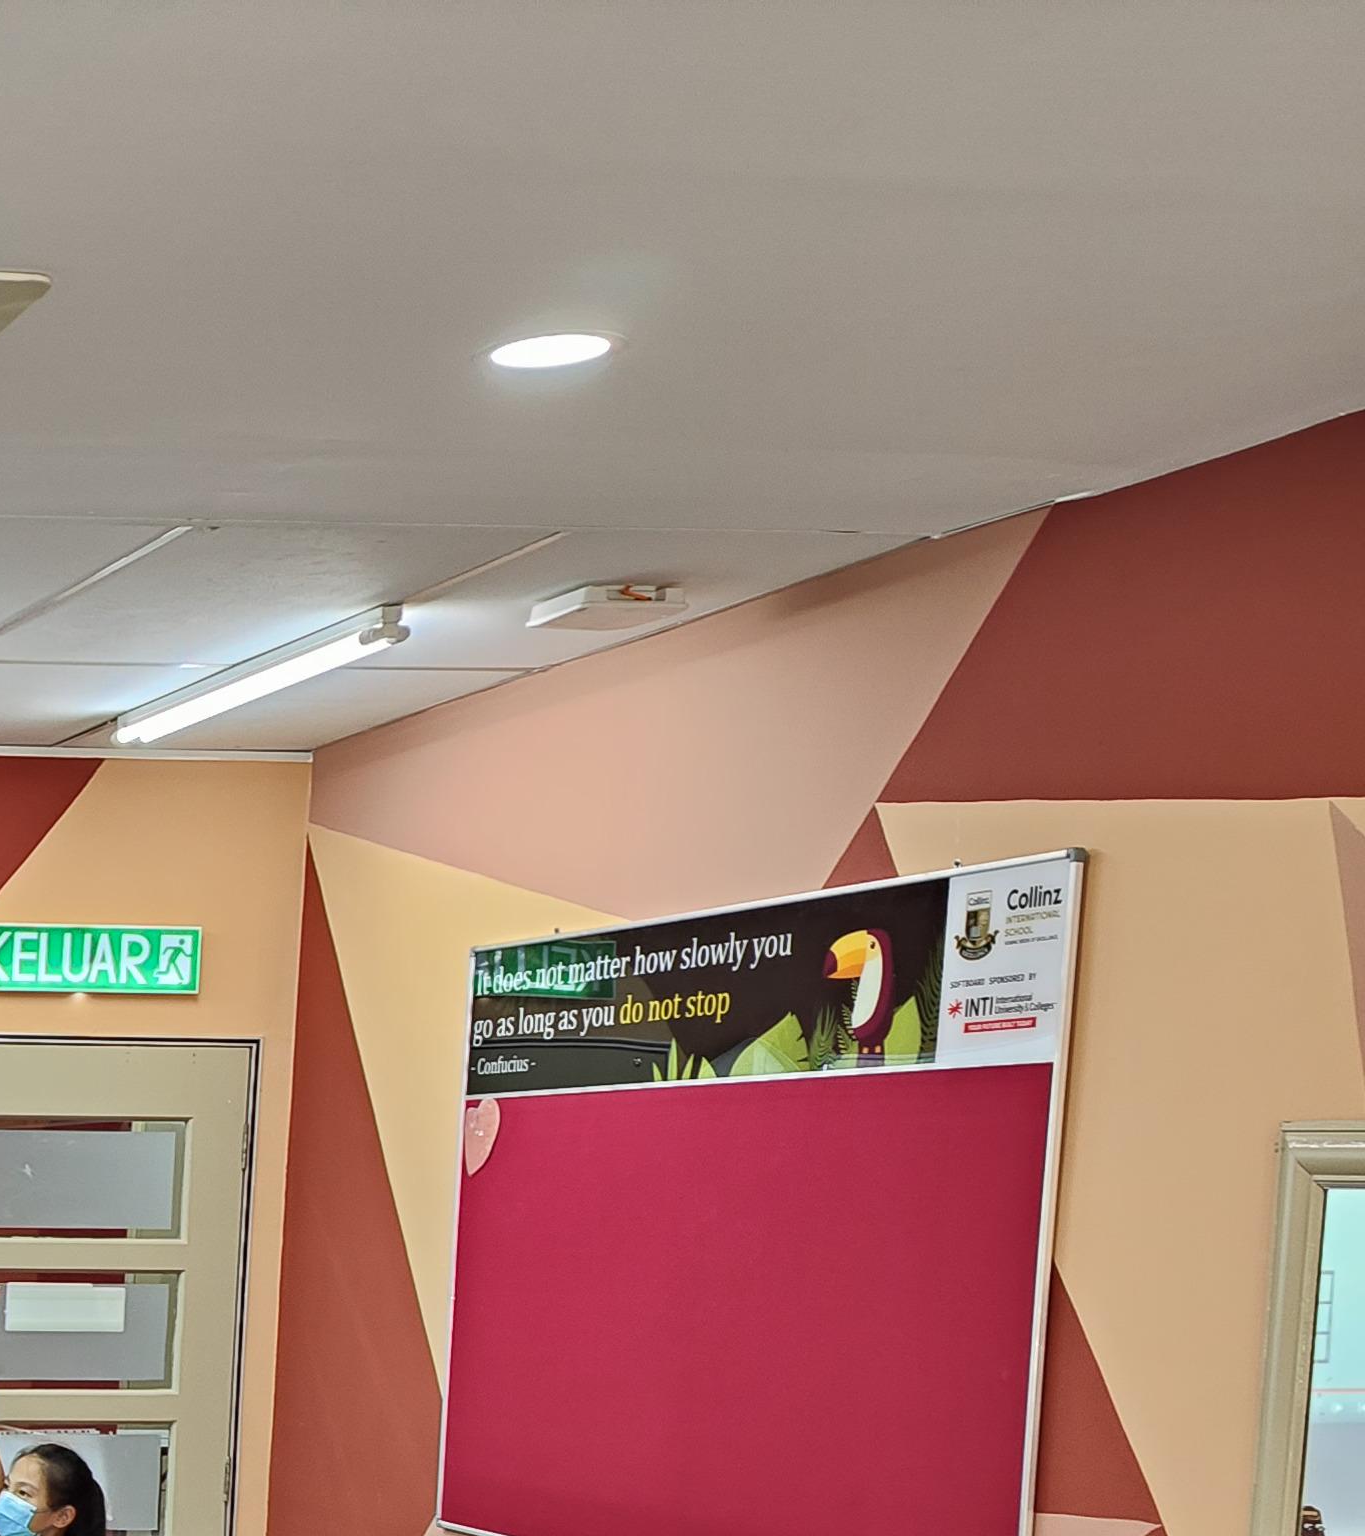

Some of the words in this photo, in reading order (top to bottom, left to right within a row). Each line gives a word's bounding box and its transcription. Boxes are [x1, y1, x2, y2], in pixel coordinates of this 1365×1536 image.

[1007, 885, 1063, 910] Collinz
[1004, 926, 1033, 937] SCHOOL
[475, 969, 491, 996] It
[493, 965, 530, 993] does
[535, 965, 565, 990] not
[569, 956, 630, 985] matter
[633, 945, 677, 976] how
[680, 932, 749, 972] slowly
[749, 932, 793, 969] you
[473, 1016, 493, 1047] go
[497, 1016, 515, 1039] as
[518, 1007, 554, 1039] long
[559, 1010, 578, 1032] as
[581, 1004, 615, 1037] you
[619, 994, 644, 1025] do
[647, 992, 682, 1023] not
[685, 989, 731, 1023] stop
[965, 996, 994, 1018] INTI
